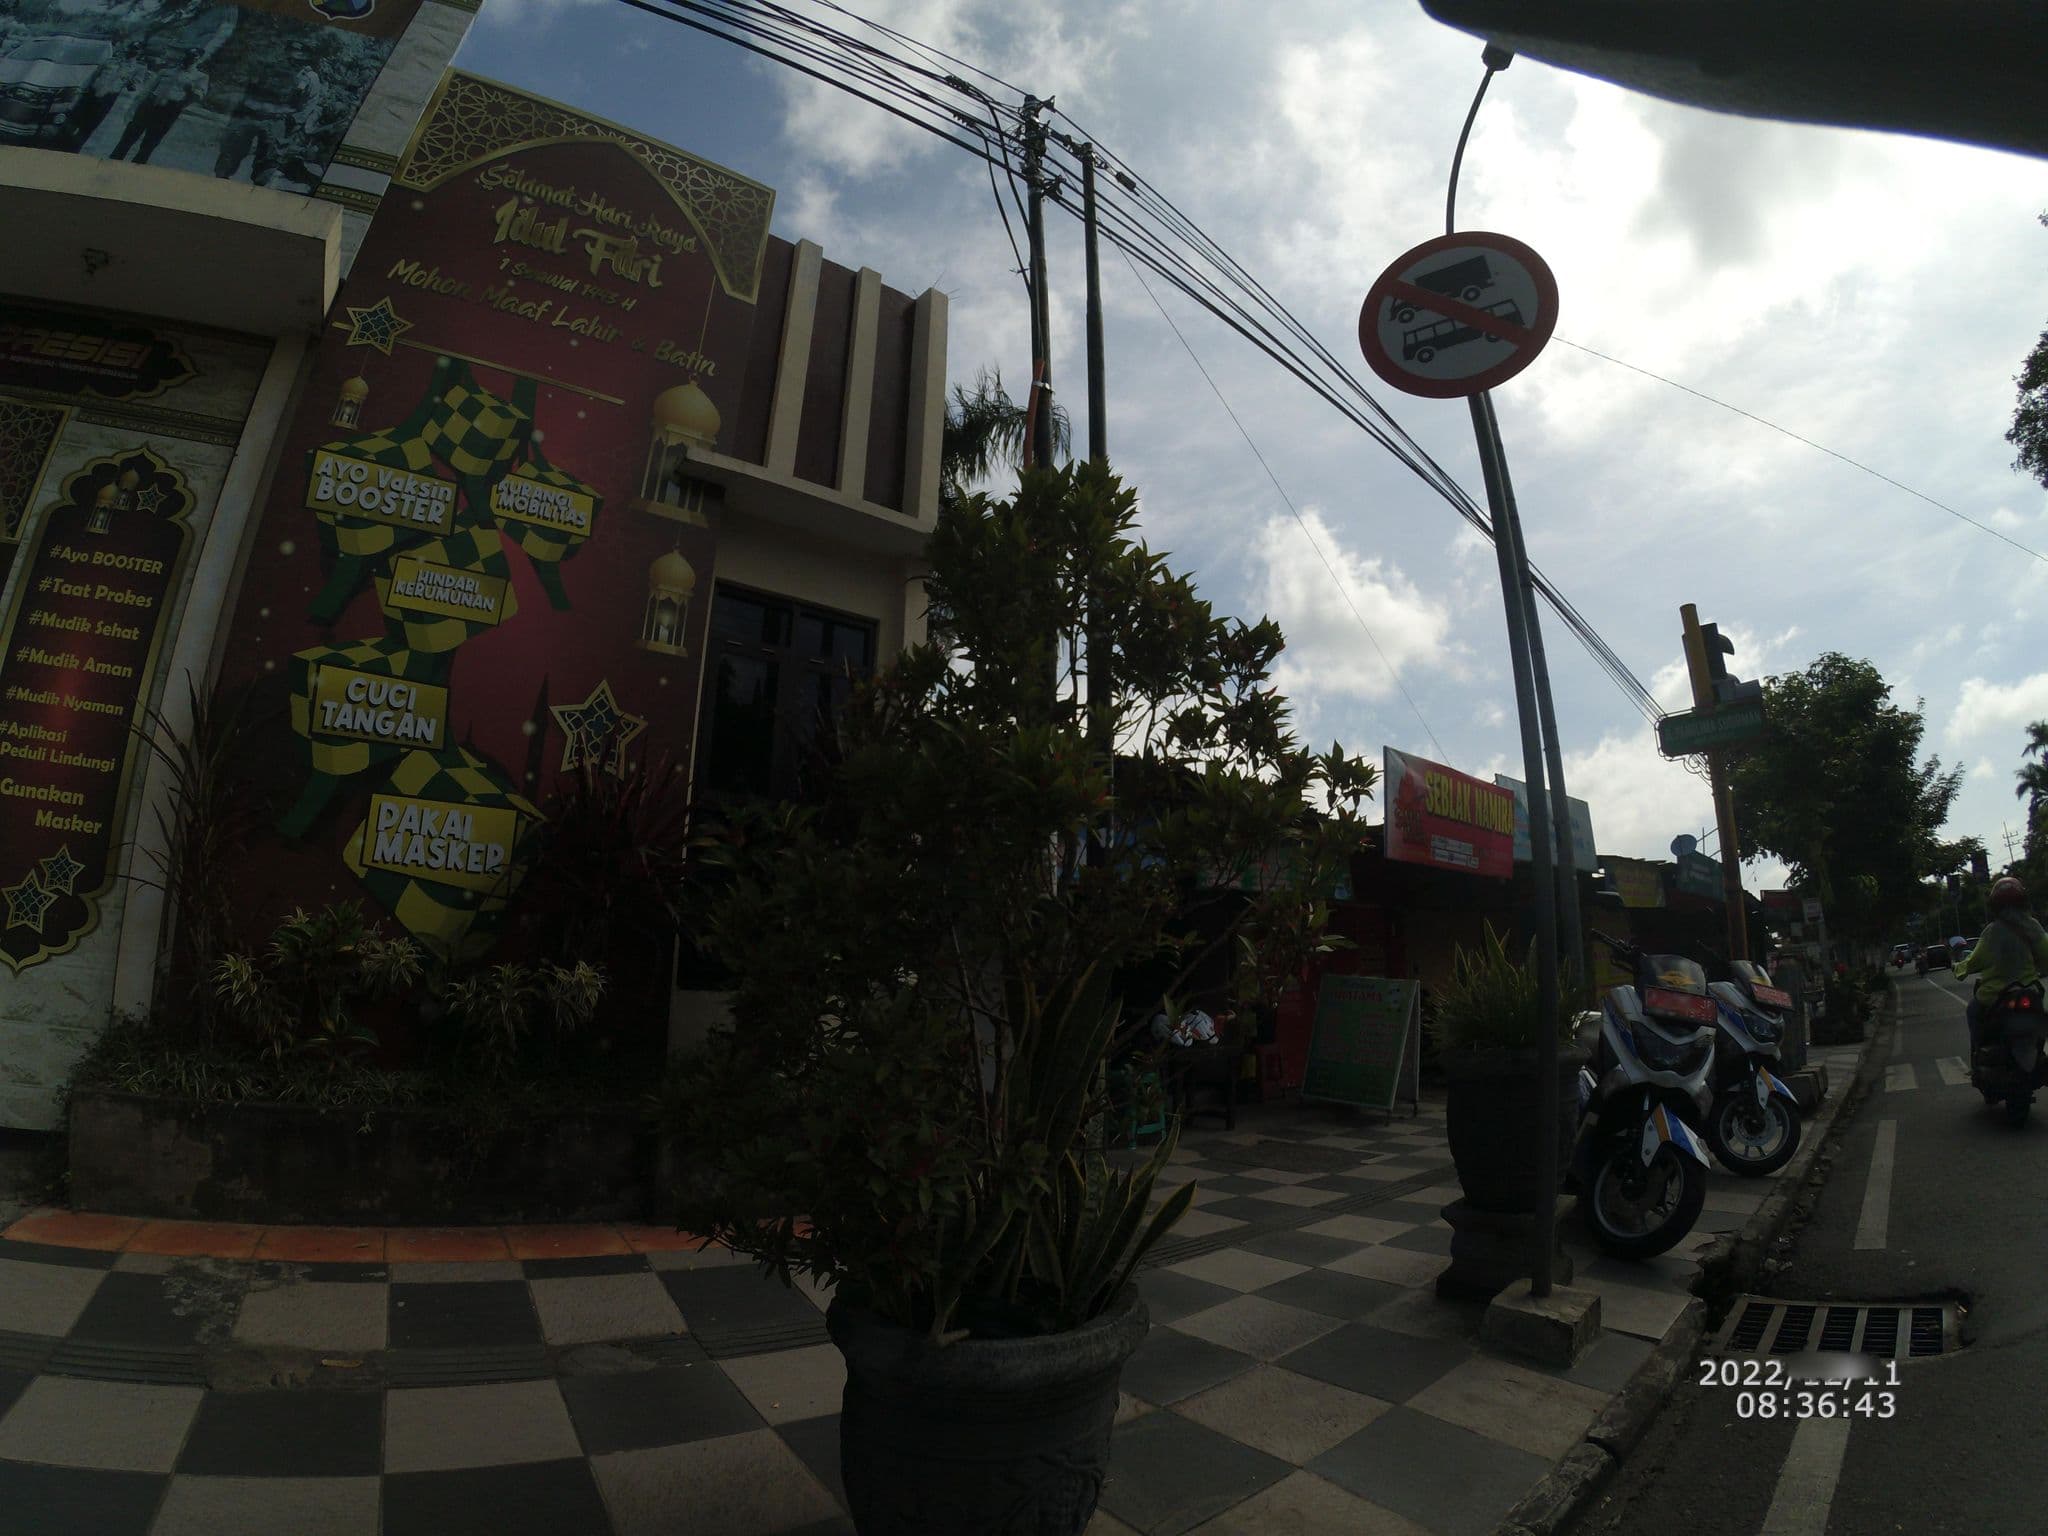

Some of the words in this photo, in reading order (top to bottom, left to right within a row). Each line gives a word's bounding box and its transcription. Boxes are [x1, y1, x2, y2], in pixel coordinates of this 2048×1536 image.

[480, 163, 575, 207] Selamat
[574, 192, 632, 229] Hari
[635, 213, 697, 255] Raya
[493, 195, 569, 255] Idul
[387, 259, 473, 298] Mohon
[480, 284, 552, 323] Maaf
[552, 305, 623, 343] Lahir
[653, 339, 717, 376] Batin
[621, 297, 637, 311] H
[317, 456, 368, 483] AYO
[377, 469, 451, 502] Vaksin
[315, 477, 447, 526] BOOSTER
[496, 494, 587, 529] MOBILITAS
[49, 544, 89, 563] #Ayo
[92, 551, 163, 574] BOOSTER
[38, 576, 91, 598] #Taat
[94, 584, 153, 608] Prokes
[394, 580, 496, 613] KERUMUNAN
[417, 569, 480, 594] HINDARI
[28, 609, 92, 632] #Mudik
[95, 620, 141, 641] Sehat
[16, 646, 80, 669] #Mudik
[83, 657, 133, 678] Aman
[5, 684, 60, 706] #Mudik
[63, 693, 125, 715] Nyaman
[346, 677, 417, 712] CUCI
[0, 720, 68, 743] #Aplikasi
[321, 700, 437, 743] TANGAN
[0, 741, 47, 761] Peduli
[49, 749, 117, 773] Lindungi
[0, 777, 85, 806] Gunakan
[1424, 771, 1472, 823] SEBLAK
[35, 808, 103, 835] Masker
[377, 802, 473, 842] PAKAI
[373, 831, 505, 874] MASKER
